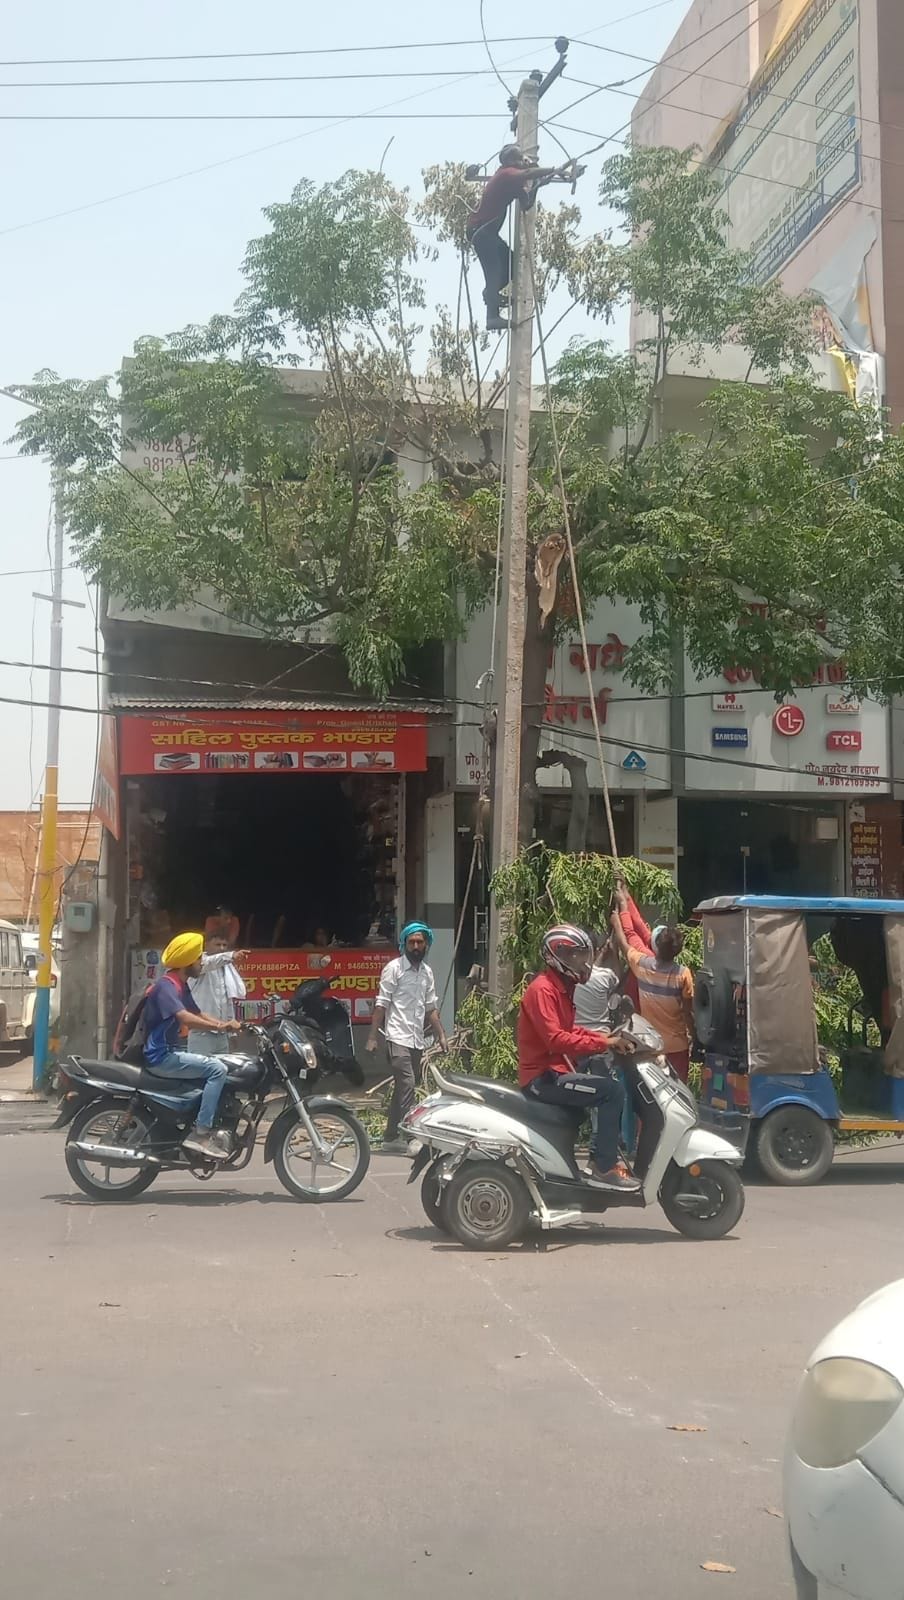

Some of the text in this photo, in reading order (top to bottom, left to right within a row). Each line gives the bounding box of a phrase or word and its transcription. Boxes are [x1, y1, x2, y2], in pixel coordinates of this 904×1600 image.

[787, 46, 824, 109] Corporation
[826, 9, 852, 56] Limited
[735, 89, 761, 140] CONTACT
[828, 703, 860, 711] BAJAJ
[775, 704, 805, 736] LG
[150, 728, 397, 749] साहिल पुस्तक भण्डार
[714, 733, 747, 742] SAMSUNG
[832, 735, 859, 746] TCL
